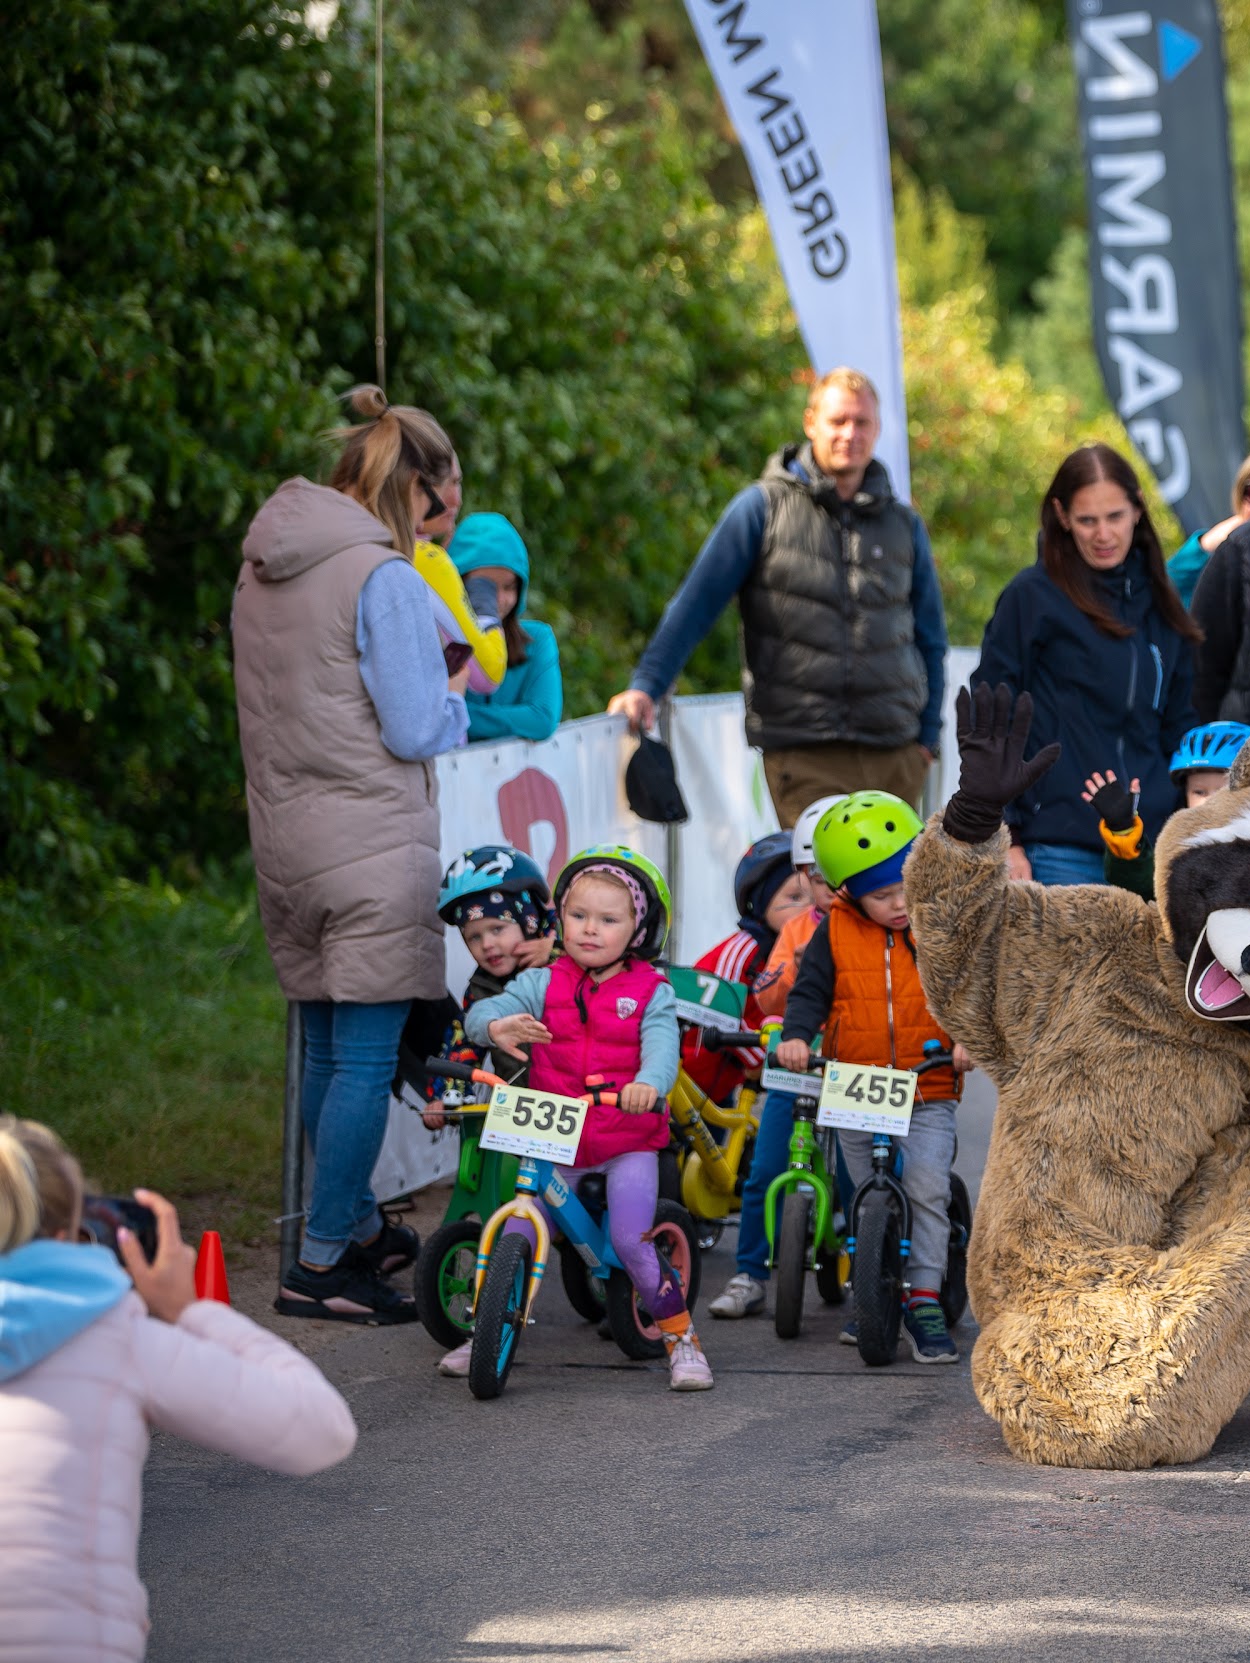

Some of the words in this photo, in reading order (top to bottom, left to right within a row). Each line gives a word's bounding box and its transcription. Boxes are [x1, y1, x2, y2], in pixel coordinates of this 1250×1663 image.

[697, 974, 720, 1006] 7
[844, 1072, 910, 1107] 455
[512, 1095, 580, 1136] 535
